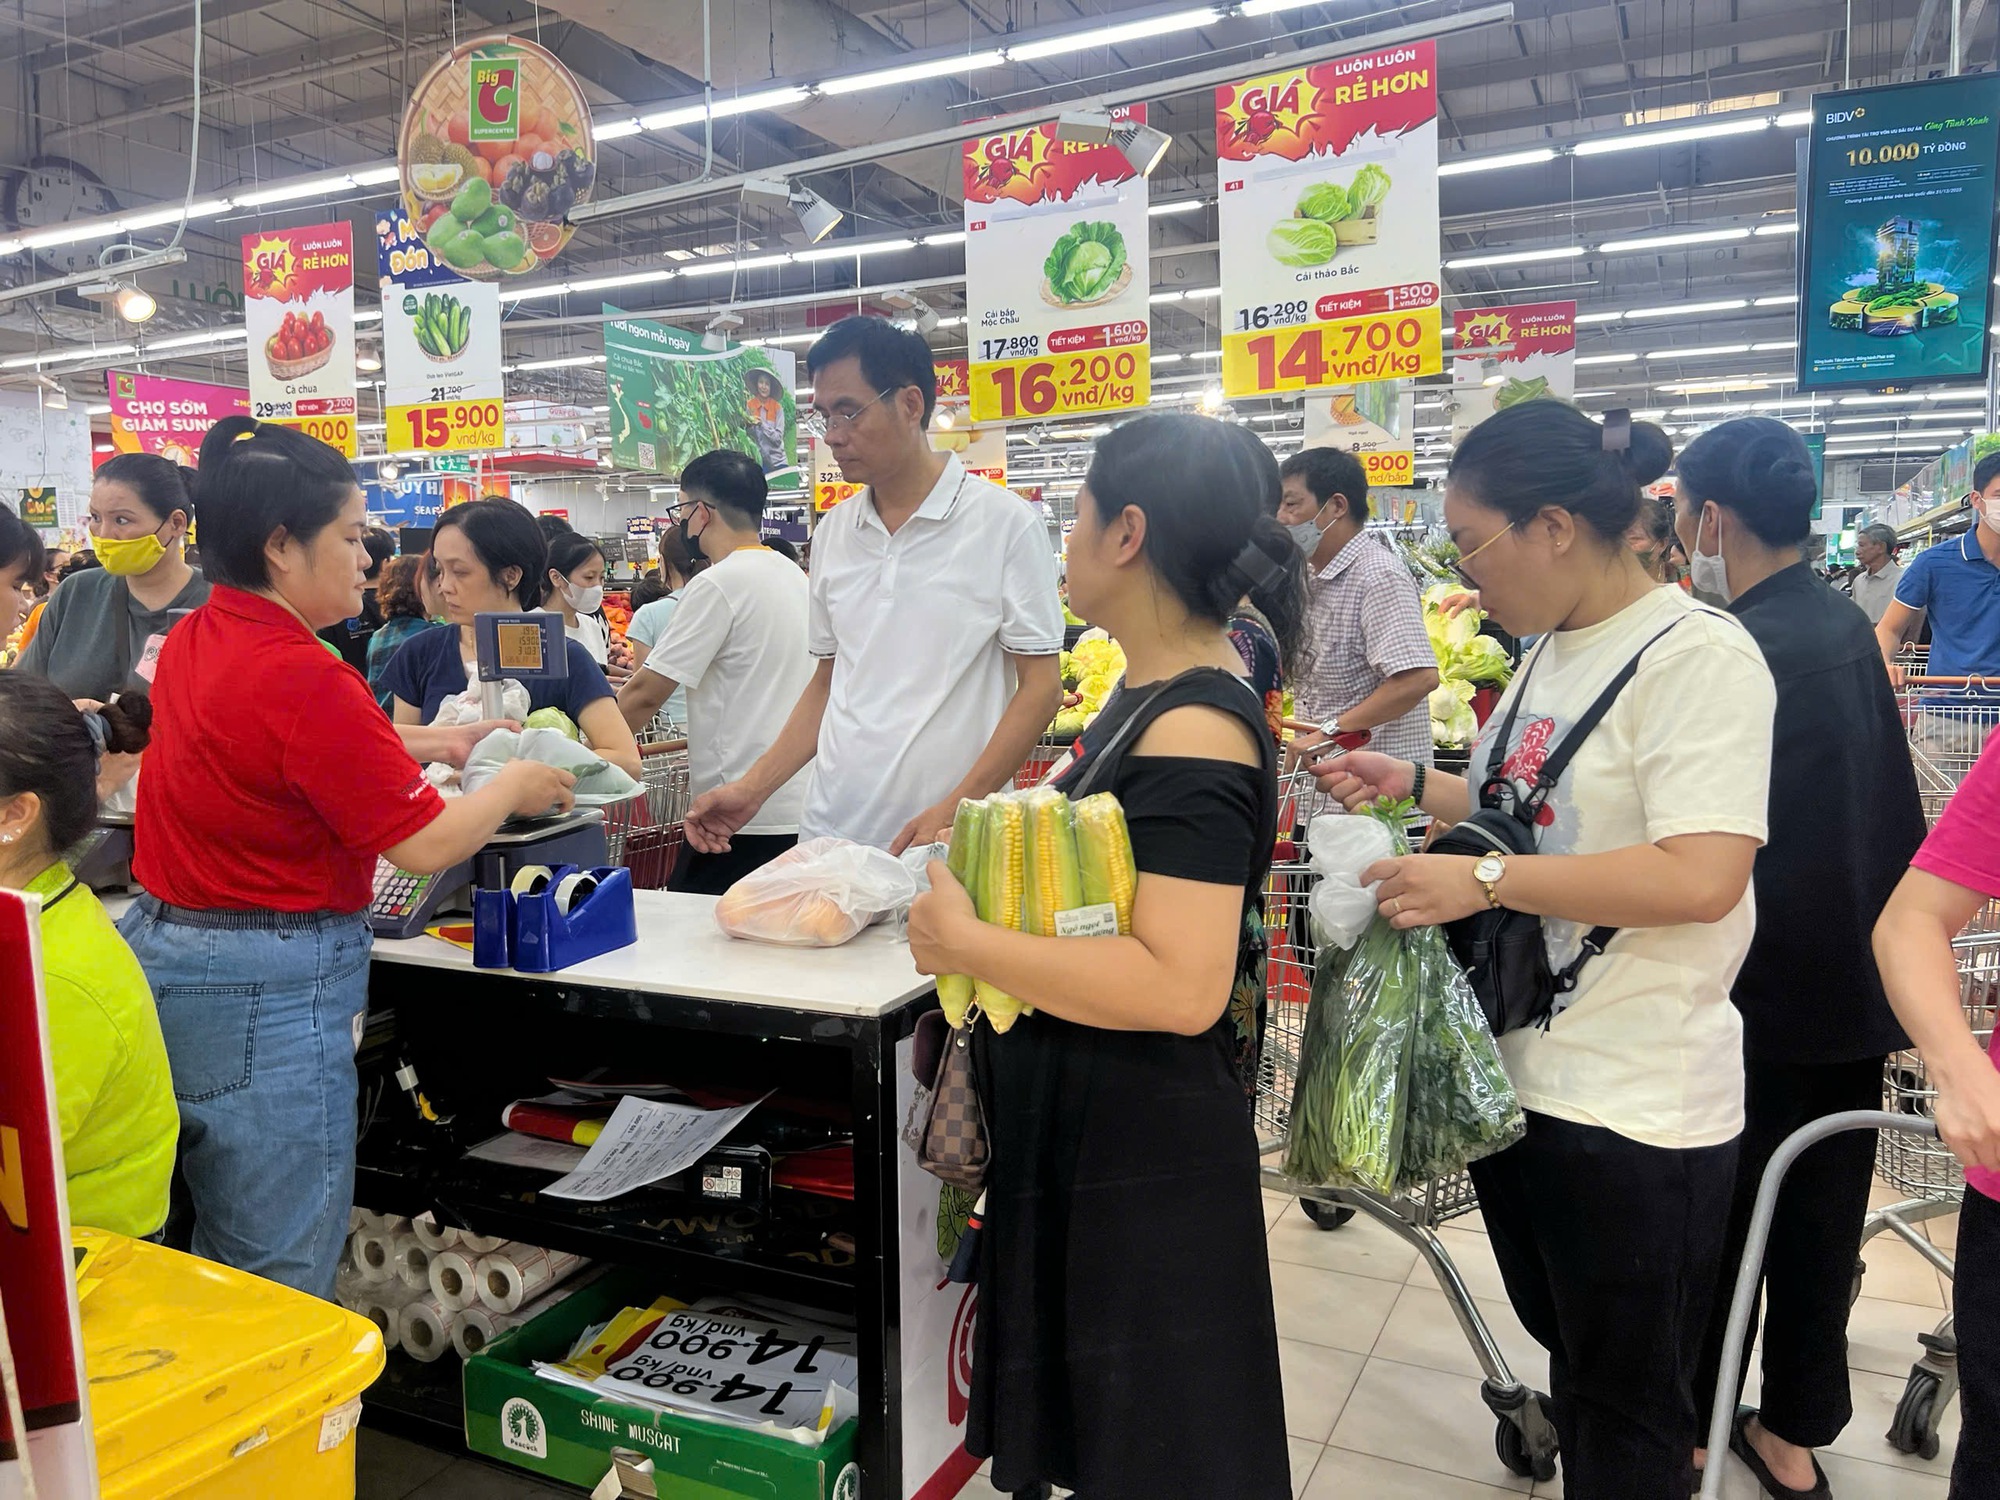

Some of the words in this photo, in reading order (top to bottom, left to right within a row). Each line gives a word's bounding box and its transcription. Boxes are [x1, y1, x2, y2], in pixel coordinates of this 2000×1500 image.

[1335, 58, 1374, 76] LUÔN
[1377, 50, 1416, 67] LUÔN
[477, 70, 500, 86] Big
[1335, 75, 1367, 105] RẺ
[1372, 69, 1428, 98] HƠN
[478, 69, 516, 124] C
[1241, 77, 1303, 114] GIÁ
[1826, 110, 1855, 124] BIDV
[1967, 116, 1989, 126] Xanh
[985, 128, 1033, 162] GIÁ
[1846, 142, 1920, 167] 10.000
[1938, 141, 1967, 153] ĐỒNG
[1229, 182, 1239, 190] 41
[398, 219, 420, 243] M
[303, 241, 321, 251] LUÔN
[323, 238, 343, 249] LUÔN
[257, 249, 287, 272] GIÁ
[303, 251, 319, 270] RẺ
[321, 253, 349, 268] HƠN
[390, 246, 429, 275] Đón
[1296, 273, 1312, 282] Cải
[1315, 268, 1338, 279] thảo
[1340, 265, 1359, 276] Bắc
[1319, 302, 1338, 313] TIẾT
[1339, 299, 1361, 312] KIỆM
[1384, 284, 1432, 310] 1.500
[1399, 297, 1432, 307] vnđ/kg
[981, 318, 997, 327] Mộc
[1000, 315, 1020, 325] Châu
[985, 311, 998, 319] Cải
[1000, 308, 1015, 318] bắp
[1239, 300, 1308, 330] 16.200
[1521, 316, 1542, 324] LUÔN
[1543, 313, 1566, 322] LUÔN
[628, 324, 651, 340] ngon
[650, 328, 668, 344] mỗi
[668, 336, 691, 352] ngày
[1051, 335, 1067, 347] TIẾT
[1068, 334, 1086, 346] KIỆM
[1102, 322, 1142, 346] 1.600
[1114, 334, 1141, 344] vnđ/kg
[1469, 321, 1504, 340] GIÁ
[1520, 324, 1538, 338] RẺ
[1541, 325, 1571, 336] HƠN
[982, 335, 1039, 360] 17.800
[1247, 318, 1422, 390] 14.700
[1331, 352, 1420, 379] vnđ/kg
[298, 384, 318, 394] chua
[431, 385, 462, 402] 21.700
[991, 352, 1135, 417] 16.200
[1062, 383, 1134, 406] vnđ/kg
[126, 400, 166, 417] CHỢ
[169, 400, 208, 416] SỚM
[326, 399, 352, 414] 2.700
[122, 414, 168, 432] GIẢM
[406, 404, 499, 448] 15.900
[1365, 455, 1408, 471] .900
[820, 472, 843, 482] 32.50
[650, 1328, 825, 1374] 14.900
[612, 1366, 793, 1415] 14.900
[580, 1409, 619, 1435] SHINE
[628, 1422, 681, 1454] MUSCAT
[510, 1438, 538, 1452] Peacock
